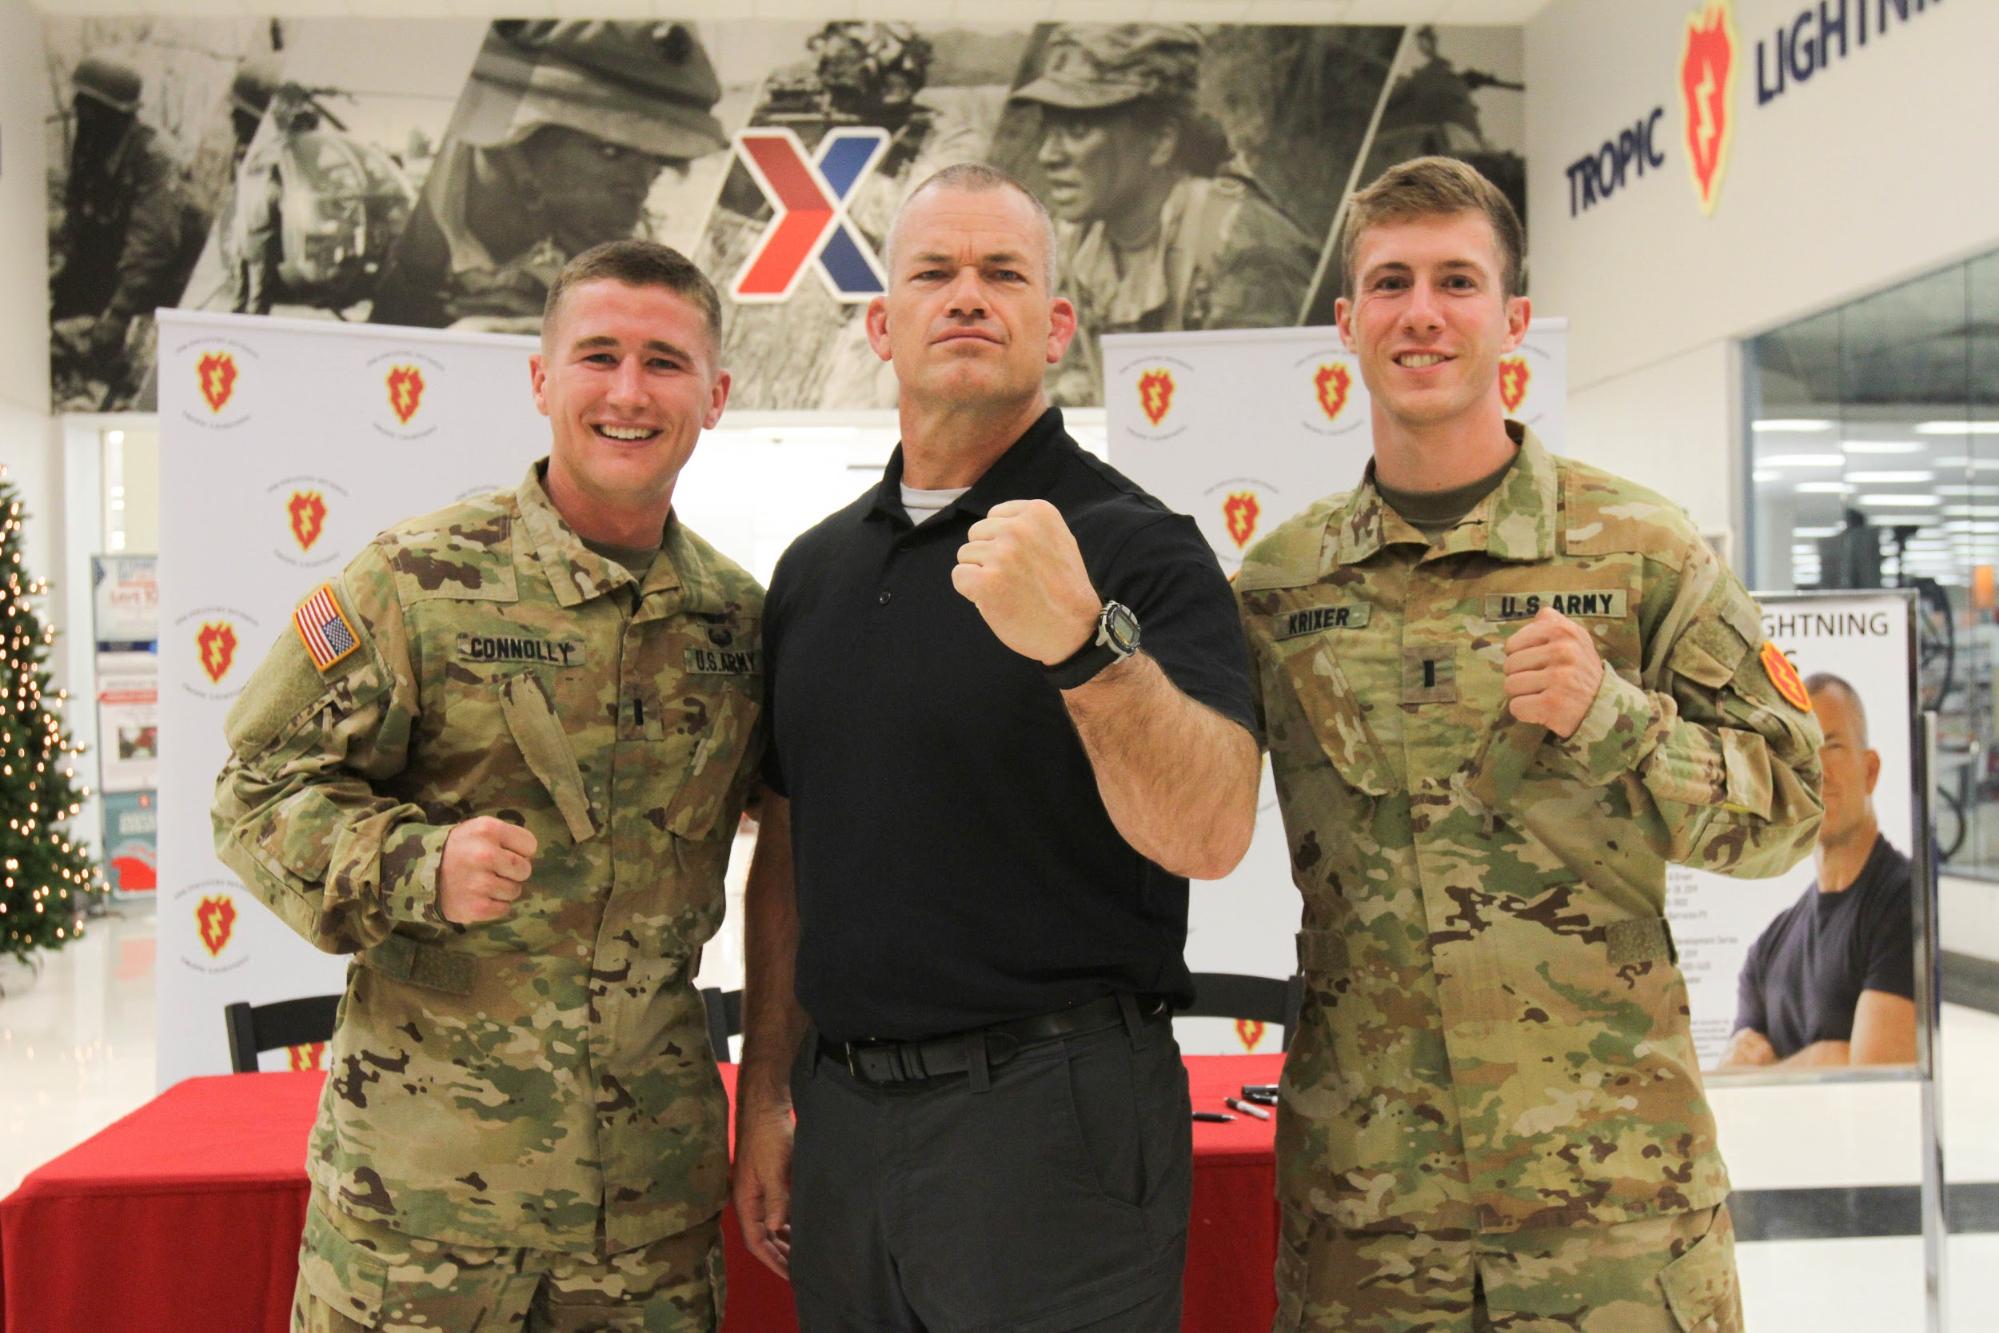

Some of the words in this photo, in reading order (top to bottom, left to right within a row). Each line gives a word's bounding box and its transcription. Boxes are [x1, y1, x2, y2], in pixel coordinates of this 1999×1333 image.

[1756, 0, 1942, 105] LIGHT
[1565, 107, 1665, 218] TROPIC
[1502, 595, 1540, 617] U.S
[1552, 594, 1613, 615] ARMY
[1760, 612, 1889, 638] GHTNING
[471, 637, 570, 665] CONNOLLY
